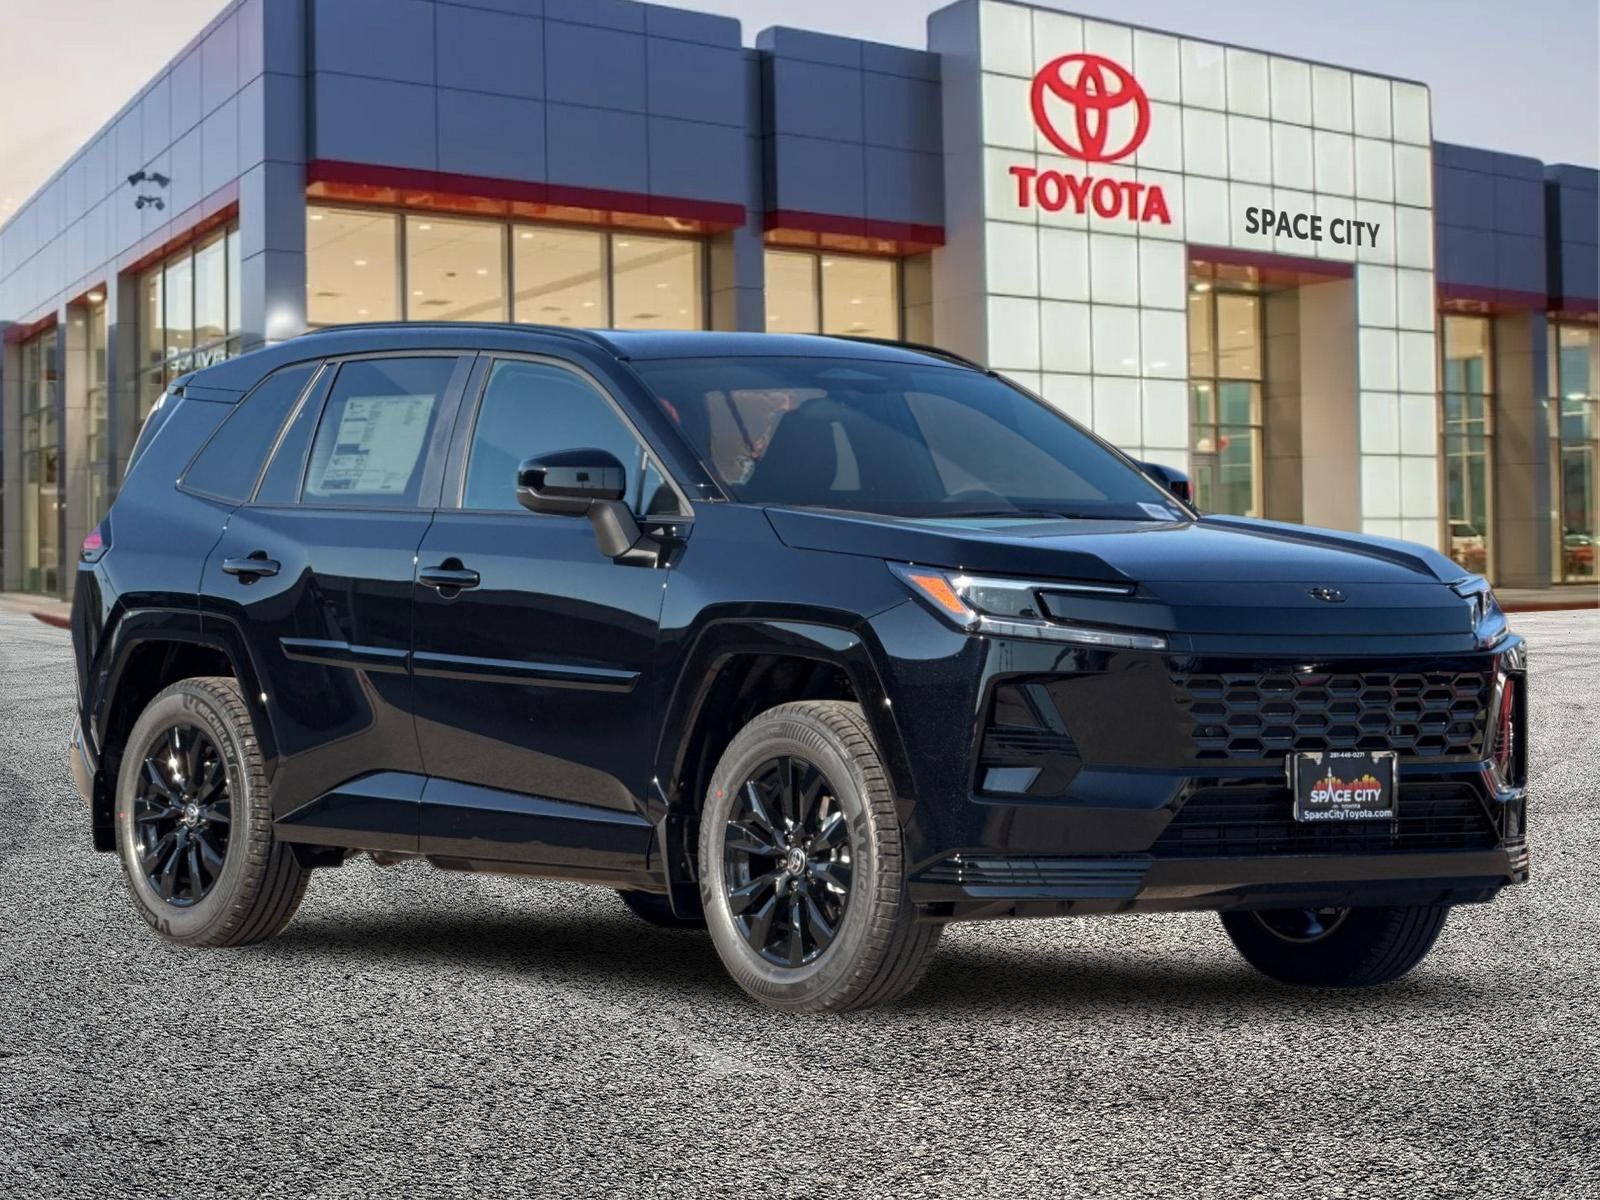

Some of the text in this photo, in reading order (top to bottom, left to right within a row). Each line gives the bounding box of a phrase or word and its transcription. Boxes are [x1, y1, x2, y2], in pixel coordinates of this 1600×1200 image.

[1009, 166, 1171, 224] TOYOTA
[1245, 206, 1380, 248] SPACE CITY
[196, 703, 234, 758] MICHELIN
[1304, 809, 1392, 820] SpaceCityToyota.com
[1310, 788, 1381, 802] SPACE CITY
